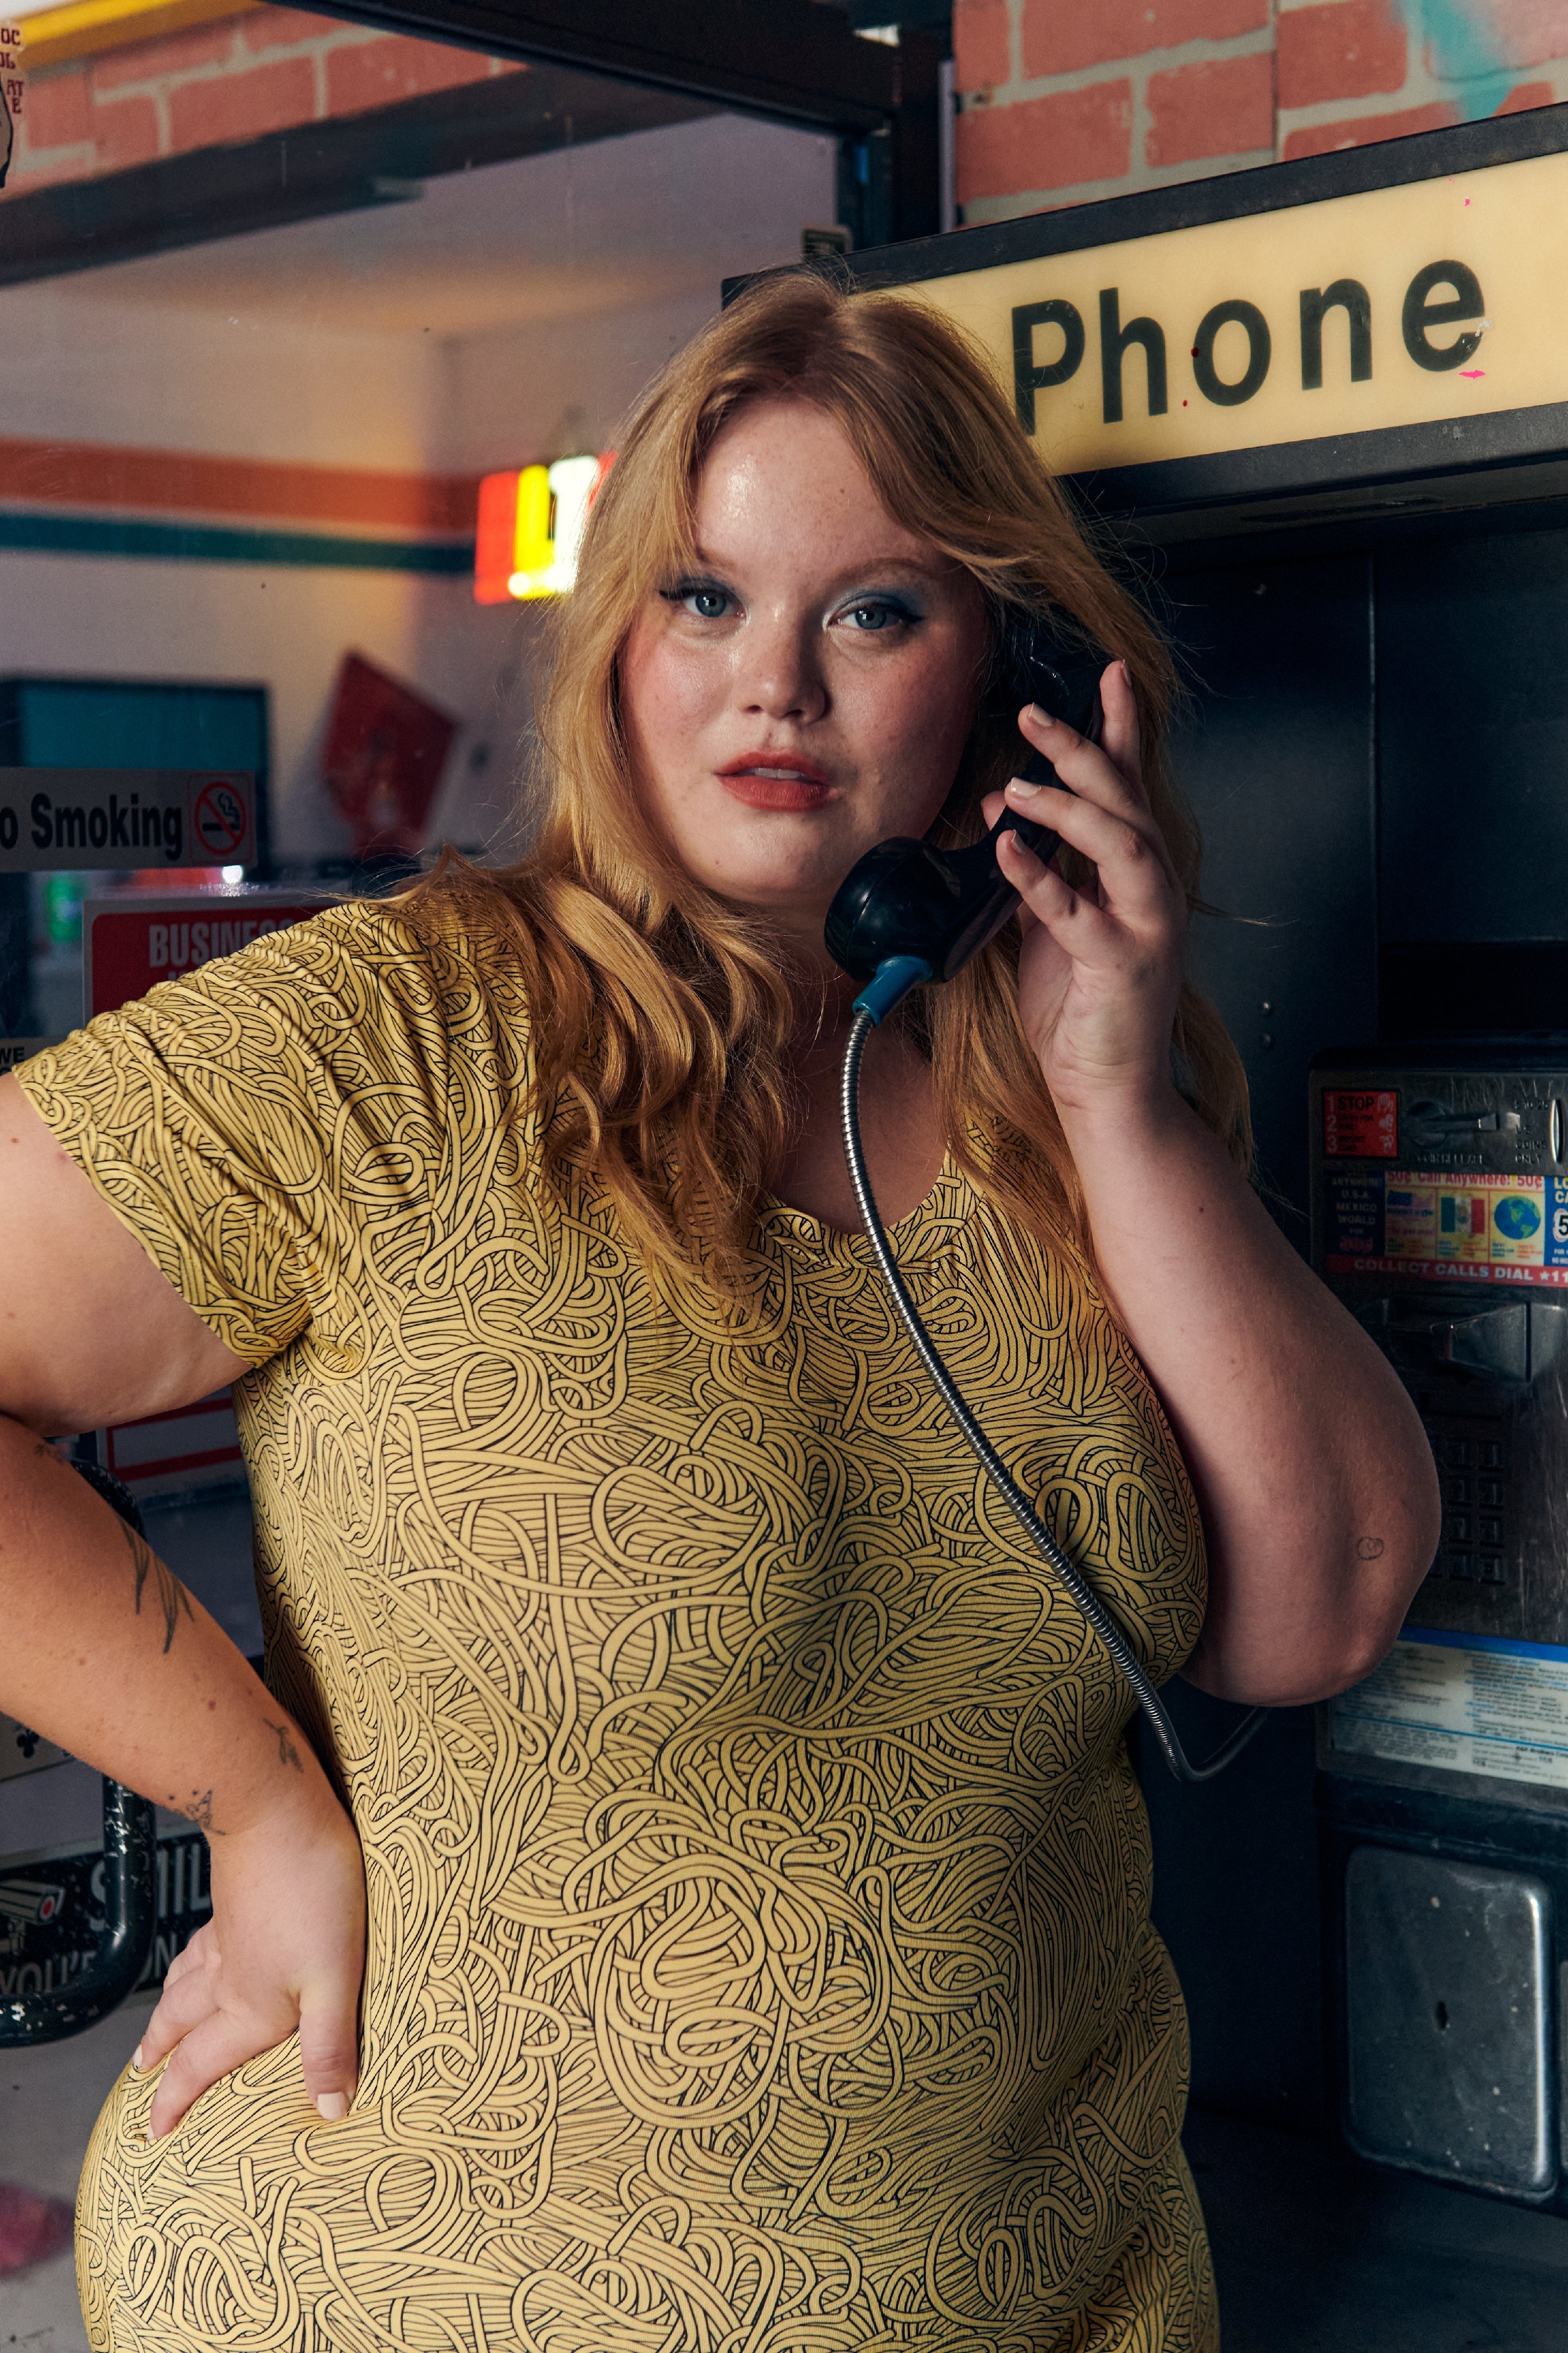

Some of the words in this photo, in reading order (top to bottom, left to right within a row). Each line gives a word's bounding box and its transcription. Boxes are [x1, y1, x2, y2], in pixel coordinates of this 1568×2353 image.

[1011, 259, 1485, 436] Phone
[30, 793, 182, 860] Smoking
[149, 918, 297, 968] BUSINE
[1338, 1096, 1374, 1111] STOP
[1354, 1259, 1430, 1273] COLLECT
[1435, 1262, 1489, 1278] CALLS
[1494, 1266, 1533, 1281] DIAL
